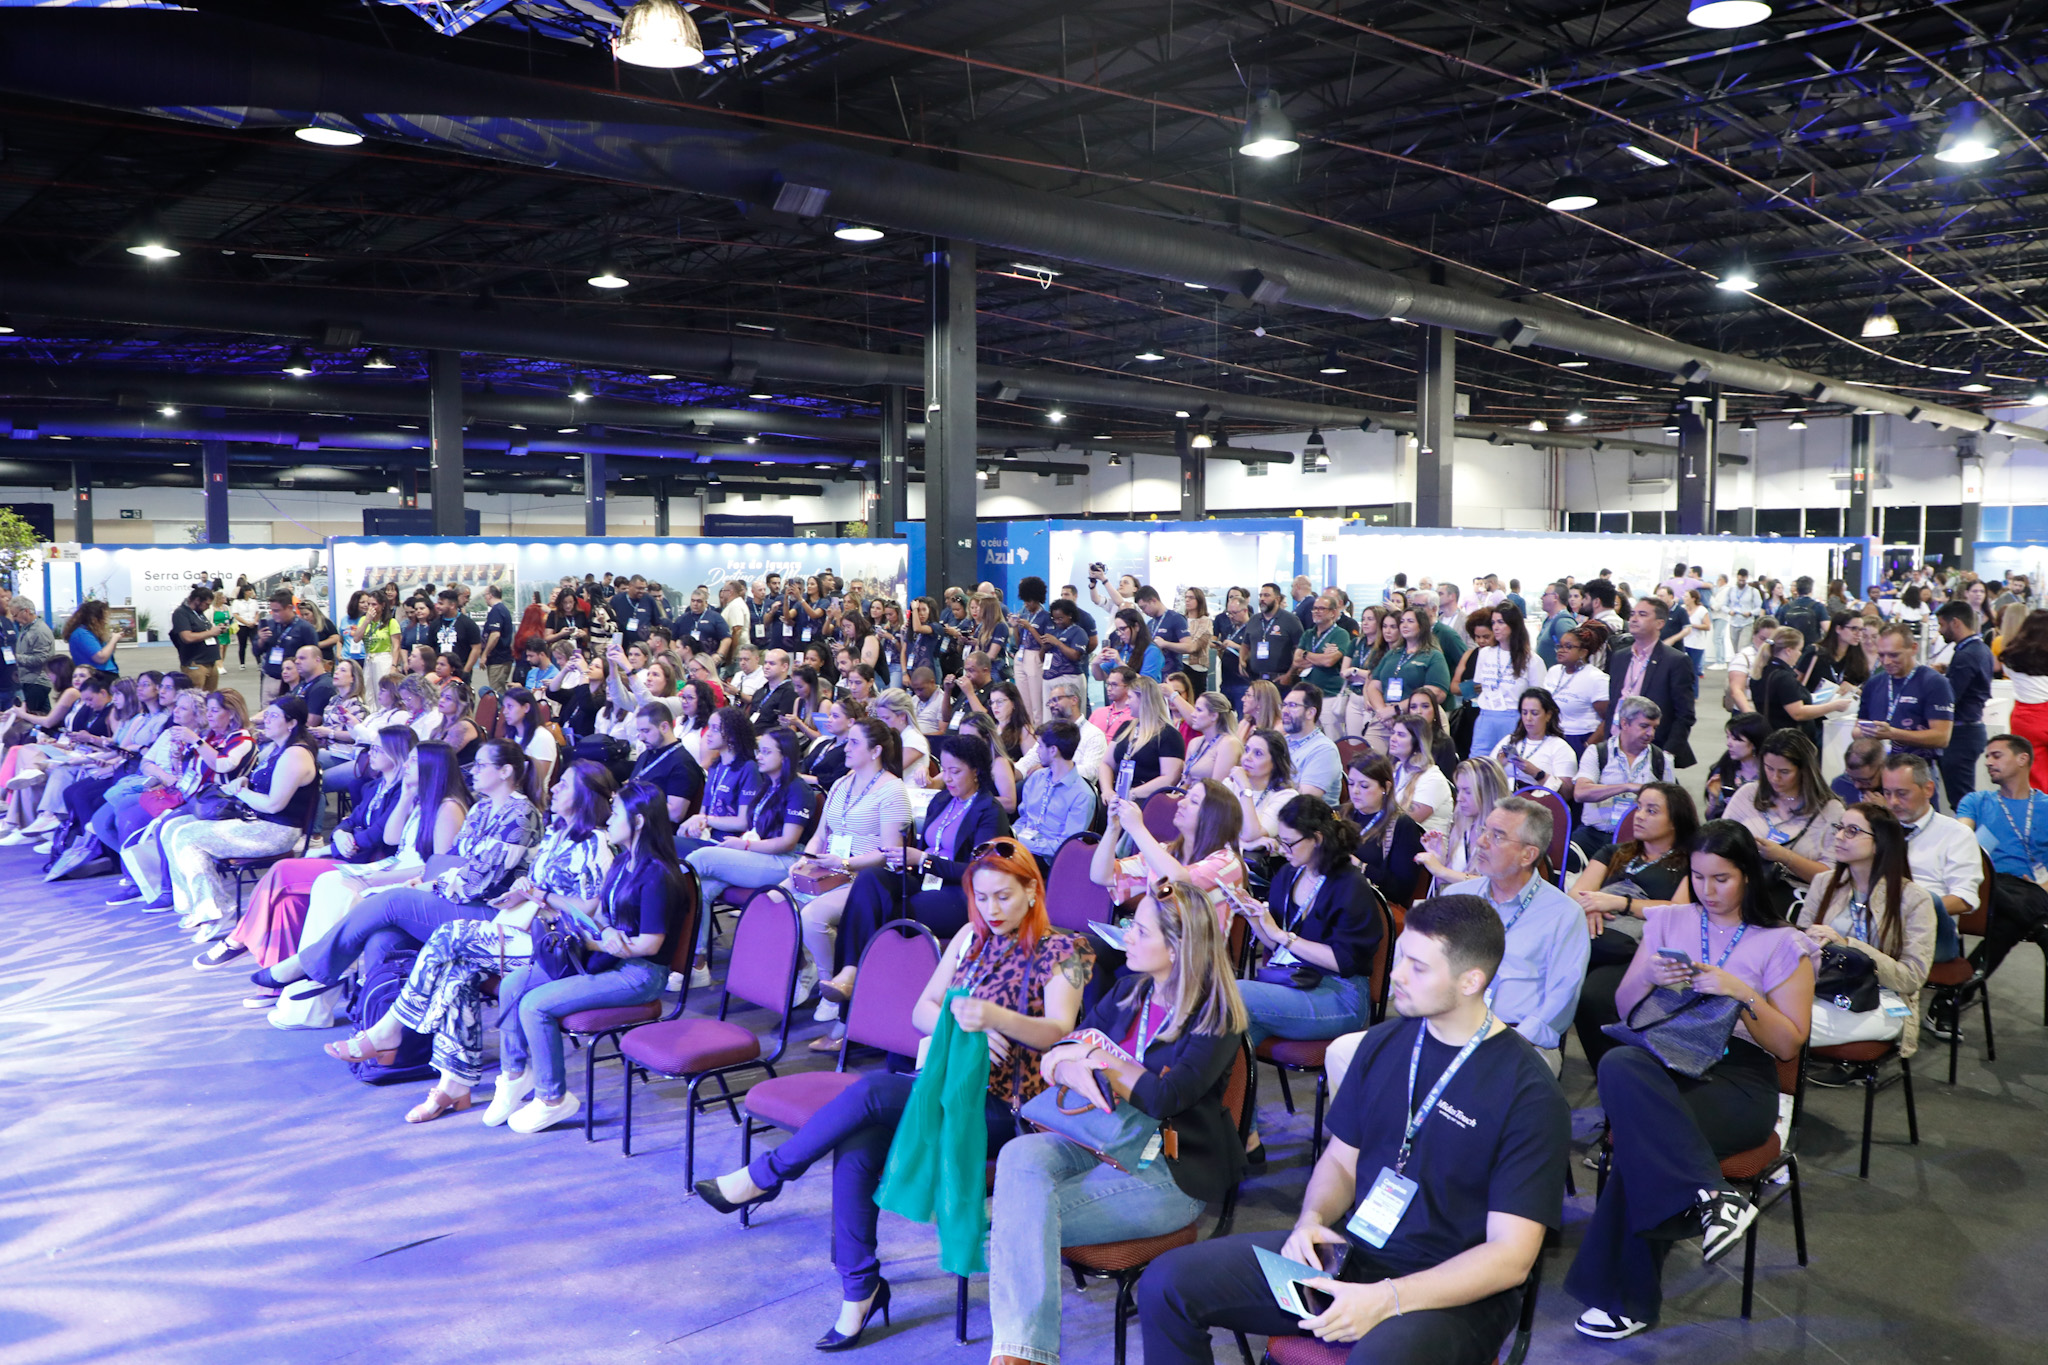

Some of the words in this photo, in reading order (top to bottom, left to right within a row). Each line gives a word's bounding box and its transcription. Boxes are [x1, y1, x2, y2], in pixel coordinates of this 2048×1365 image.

[980, 539, 987, 548] o
[988, 537, 1002, 548] céu
[984, 548, 1015, 565] Azul
[727, 559, 746, 570] Foz
[748, 559, 763, 570] do
[144, 570, 179, 581] Serra
[183, 570, 233, 580] Gacha
[144, 584, 152, 592] o
[153, 584, 173, 592] ano
[1422, 1094, 1436, 1113] Azul
